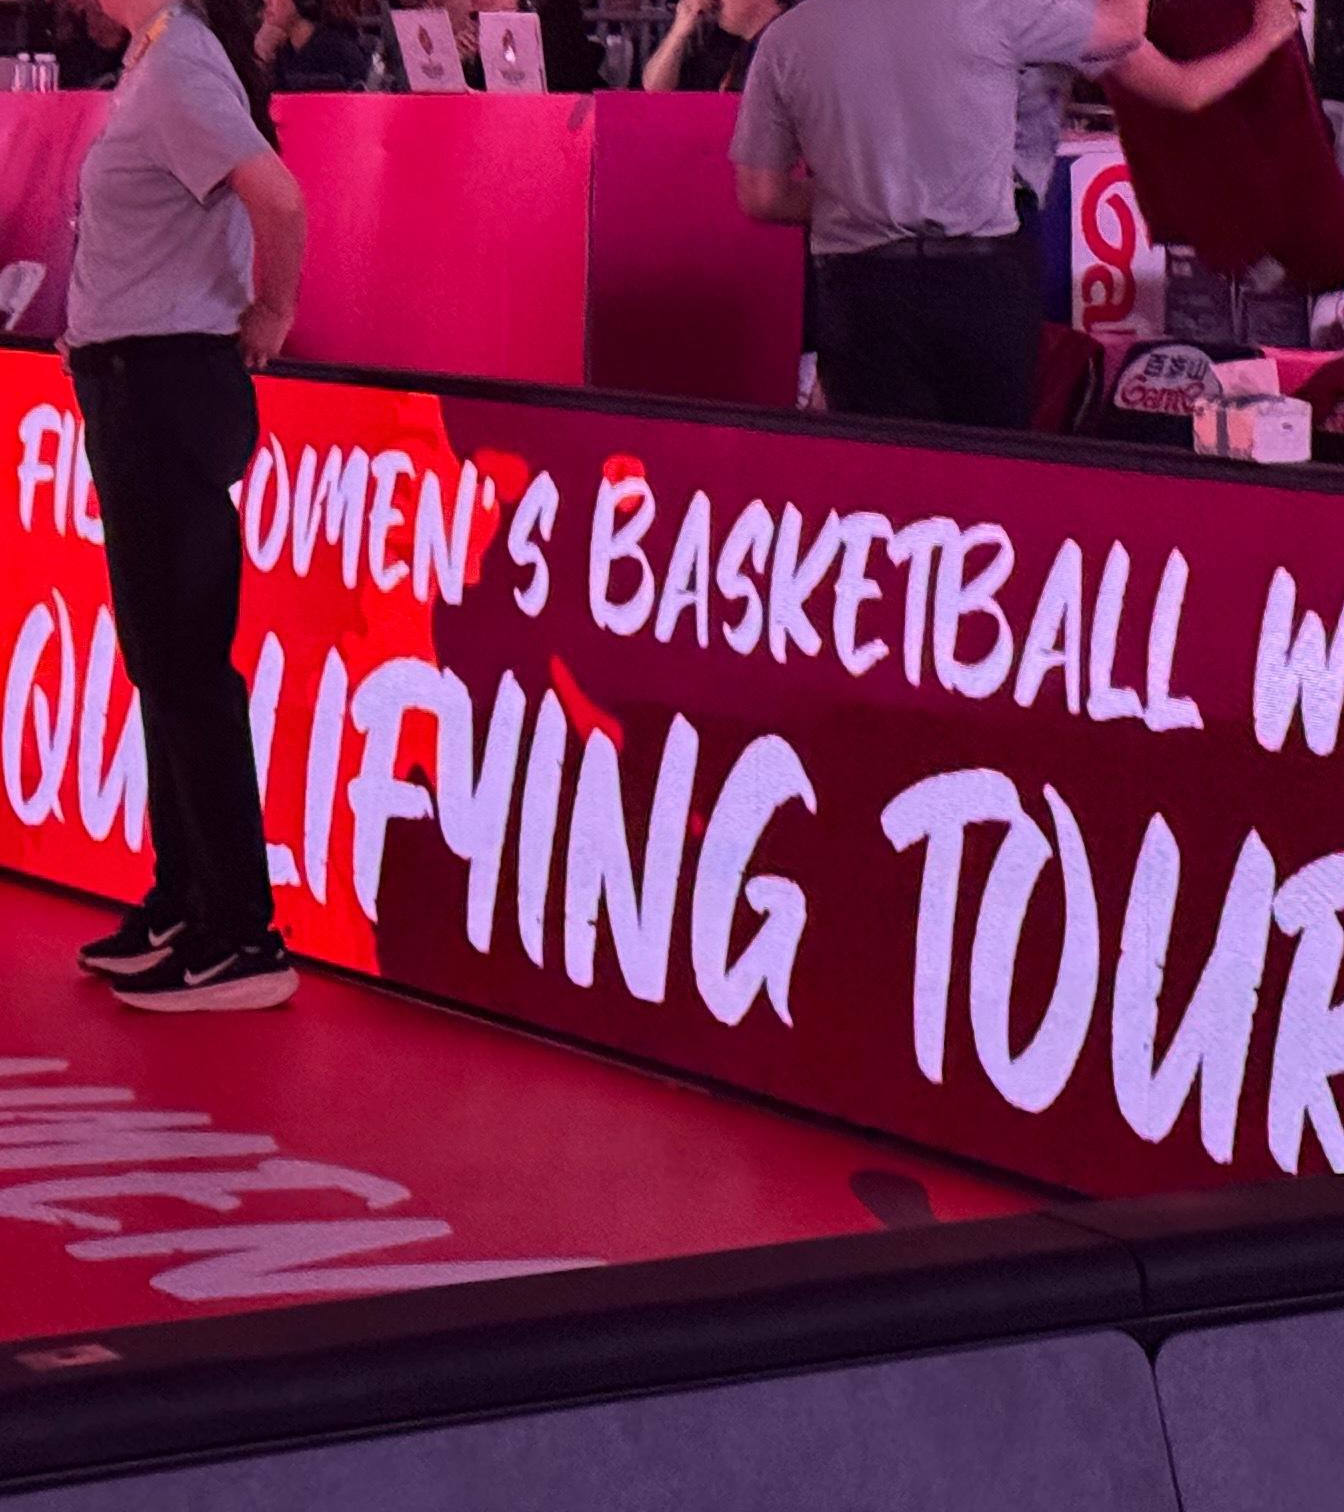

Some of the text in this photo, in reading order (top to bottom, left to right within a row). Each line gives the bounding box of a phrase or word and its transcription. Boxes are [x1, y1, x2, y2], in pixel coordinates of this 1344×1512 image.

[228, 431, 559, 617] OMEN'S
[586, 472, 1205, 733] BASKETBALL
[1, 586, 819, 1029] QULIFYING
